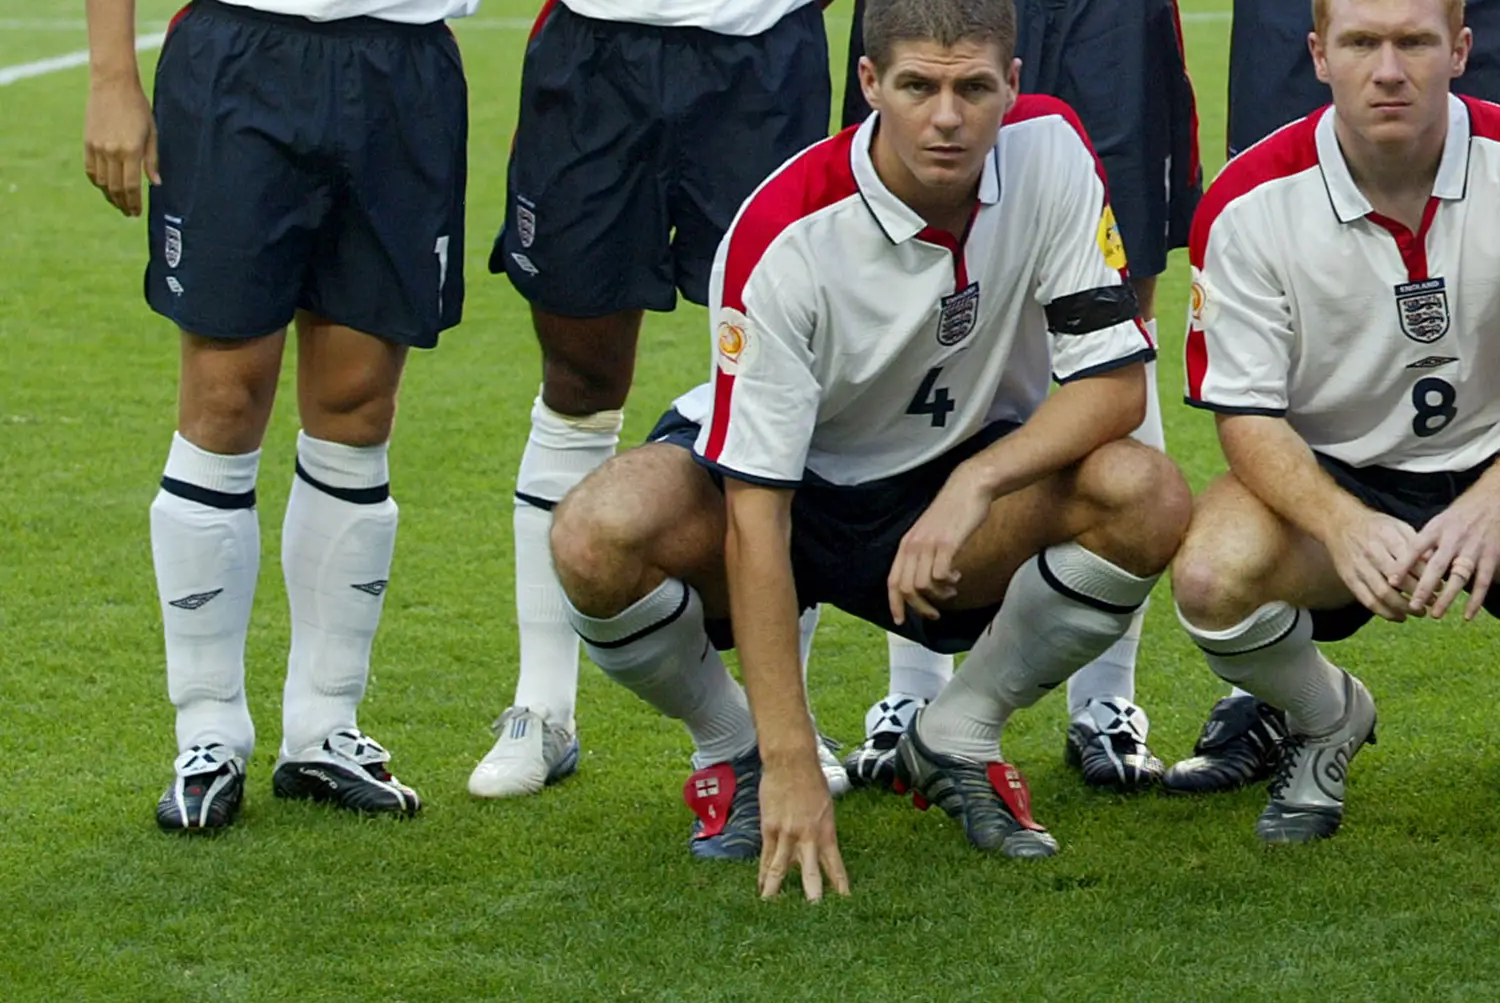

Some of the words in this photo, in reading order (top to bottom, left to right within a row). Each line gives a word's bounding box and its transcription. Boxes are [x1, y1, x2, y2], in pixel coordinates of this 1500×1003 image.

[1400, 280, 1440, 293] ENGLAND
[906, 366, 955, 428] 4
[1412, 377, 1458, 438] 8
